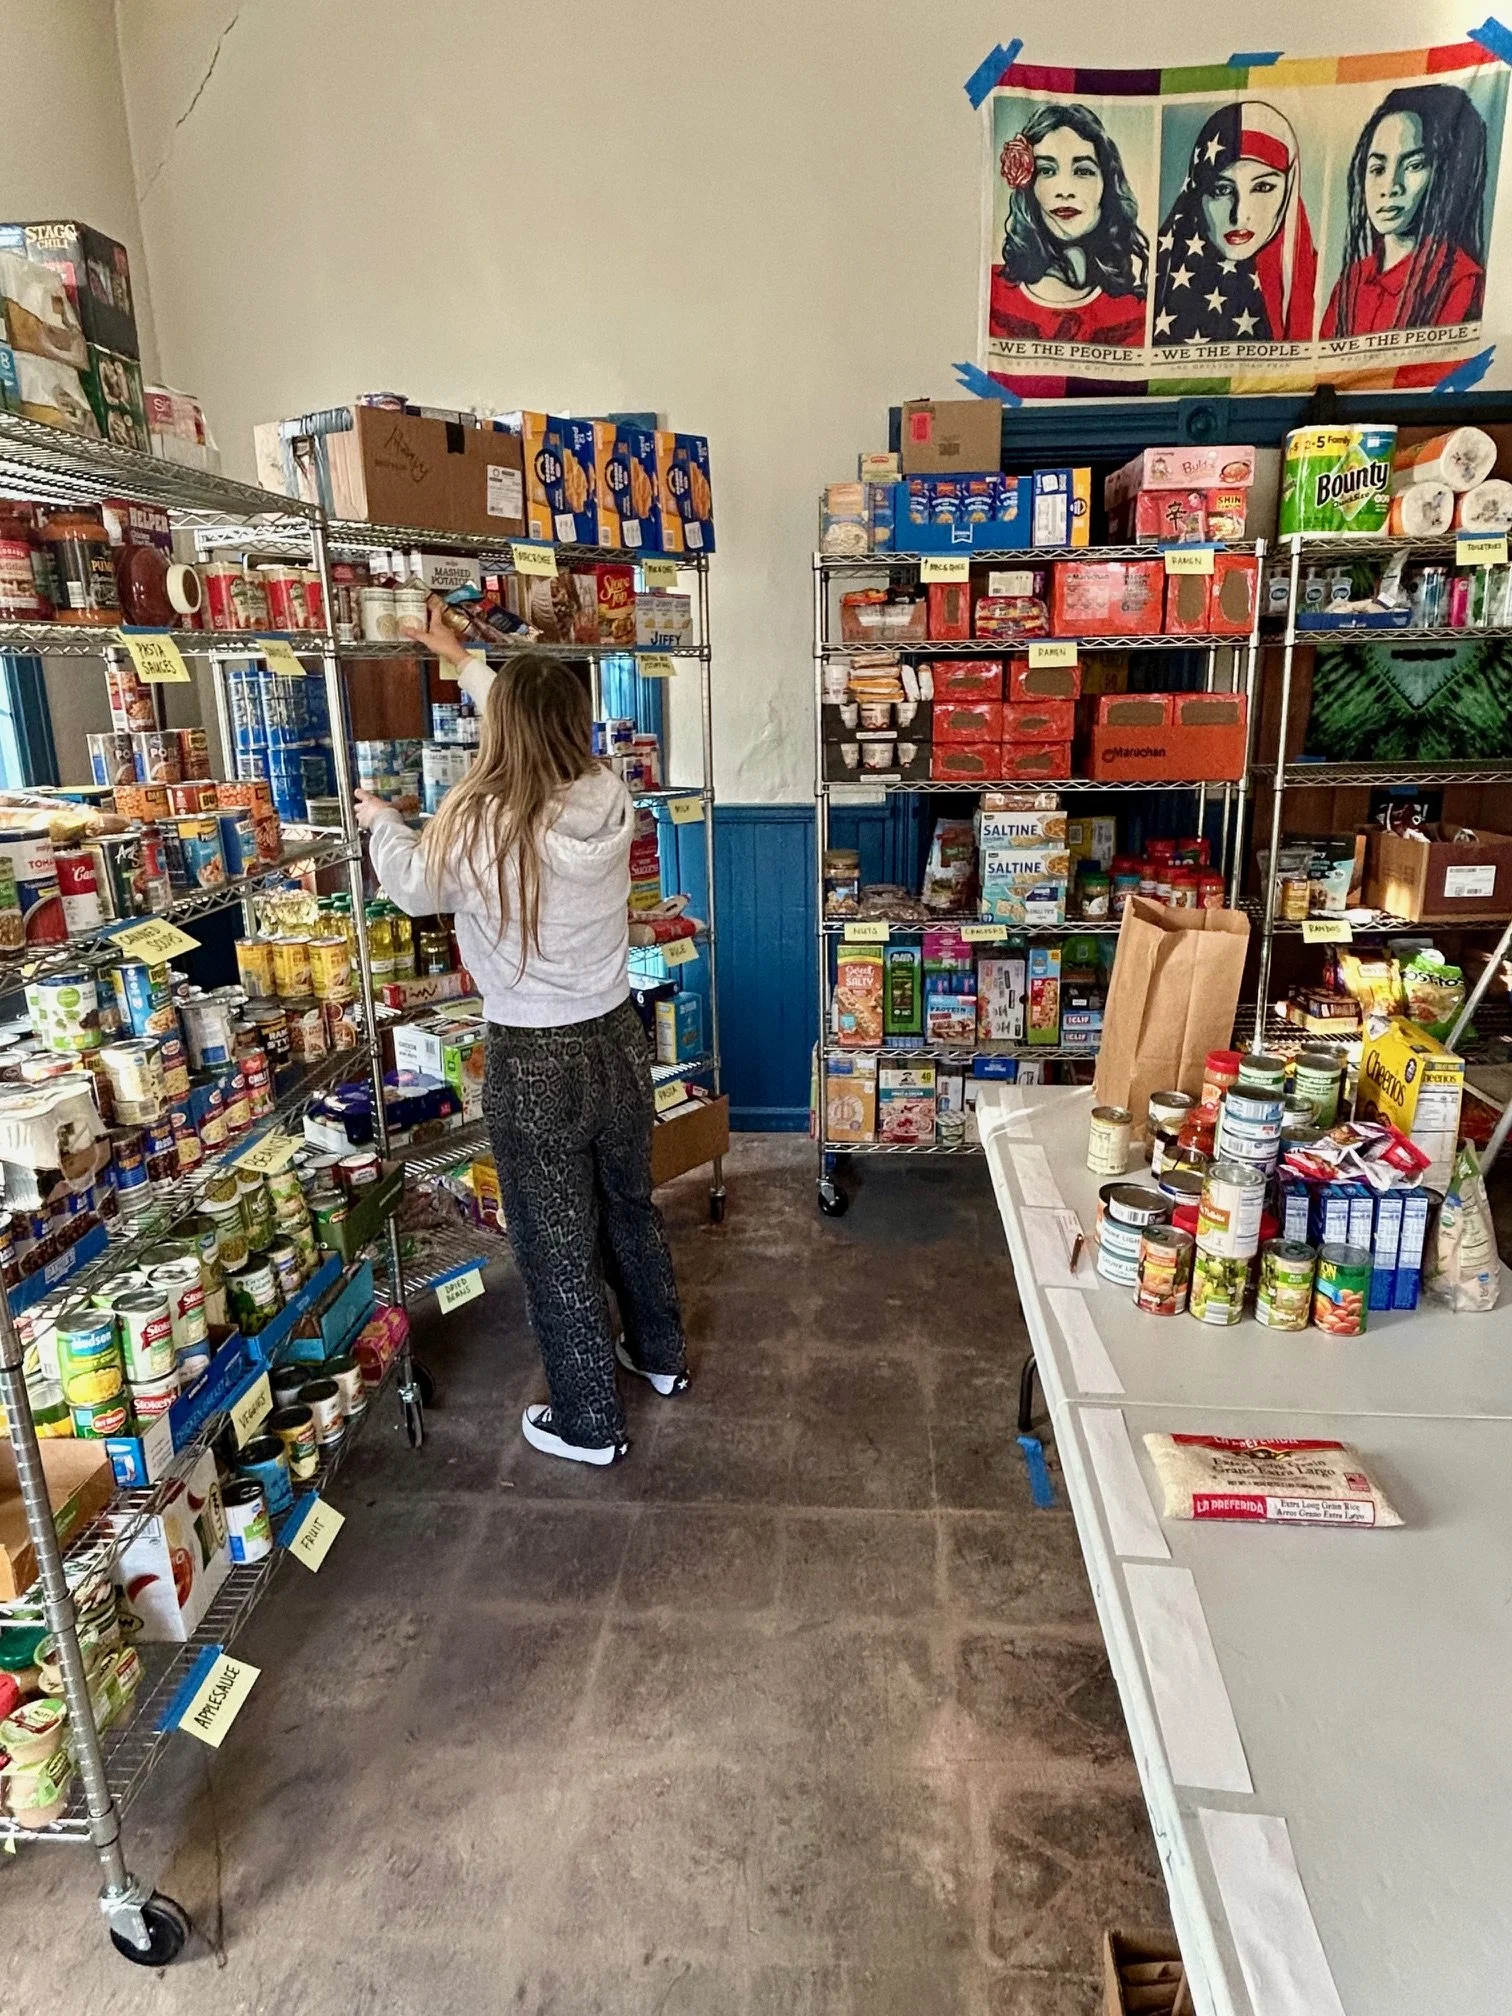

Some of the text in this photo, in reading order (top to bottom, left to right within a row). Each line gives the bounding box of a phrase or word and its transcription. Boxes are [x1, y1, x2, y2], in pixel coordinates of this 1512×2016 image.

[37, 239, 69, 250] CHILI
[1329, 327, 1469, 353] WE THE PEOPLE
[1000, 341, 1133, 361] WE THE PEOPLE
[1162, 344, 1301, 360] WE THE PEOPLE
[1328, 435, 1351, 446] Family
[1316, 461, 1389, 507] Bounty
[1166, 500, 1187, 532] 辛
[1171, 556, 1202, 566] RAMEN
[434, 567, 471, 578] MASHED
[650, 630, 682, 646] JIFFY
[135, 641, 163, 660] PASTA
[1038, 647, 1067, 657] RAMEN
[142, 659, 177, 676] SAUCES
[1112, 745, 1167, 759] Maruchan
[984, 824, 1038, 837] SALTINE
[988, 862, 1042, 874] SALTINE
[119, 925, 161, 946] CANNED
[853, 927, 878, 935] NUTS
[146, 932, 184, 952] SOUPS
[846, 977, 874, 987] SALTY
[636, 991, 645, 1004] 6
[1072, 1016, 1090, 1024] CLIF
[921, 1071, 932, 1082] 40
[1366, 1049, 1407, 1107] Cheerios
[1424, 1074, 1457, 1084] heerios
[658, 1085, 677, 1100] PASTA
[244, 1136, 293, 1169] BEANS
[445, 1278, 468, 1294] DRIED
[447, 1288, 472, 1303] BEANS
[238, 1394, 267, 1430] VEGGIES
[1213, 1465, 1335, 1478] Grano Extra Largo
[1196, 1498, 1264, 1515] LA PREFERIDA
[1280, 1499, 1360, 1511] Extra Long Grain Rice
[1299, 1510, 1322, 1518] Grano
[1324, 1510, 1343, 1519] Extra
[1345, 1512, 1365, 1521] Largo
[301, 1517, 325, 1551] FRUIT
[193, 1664, 241, 1730] APPLESAUCE
